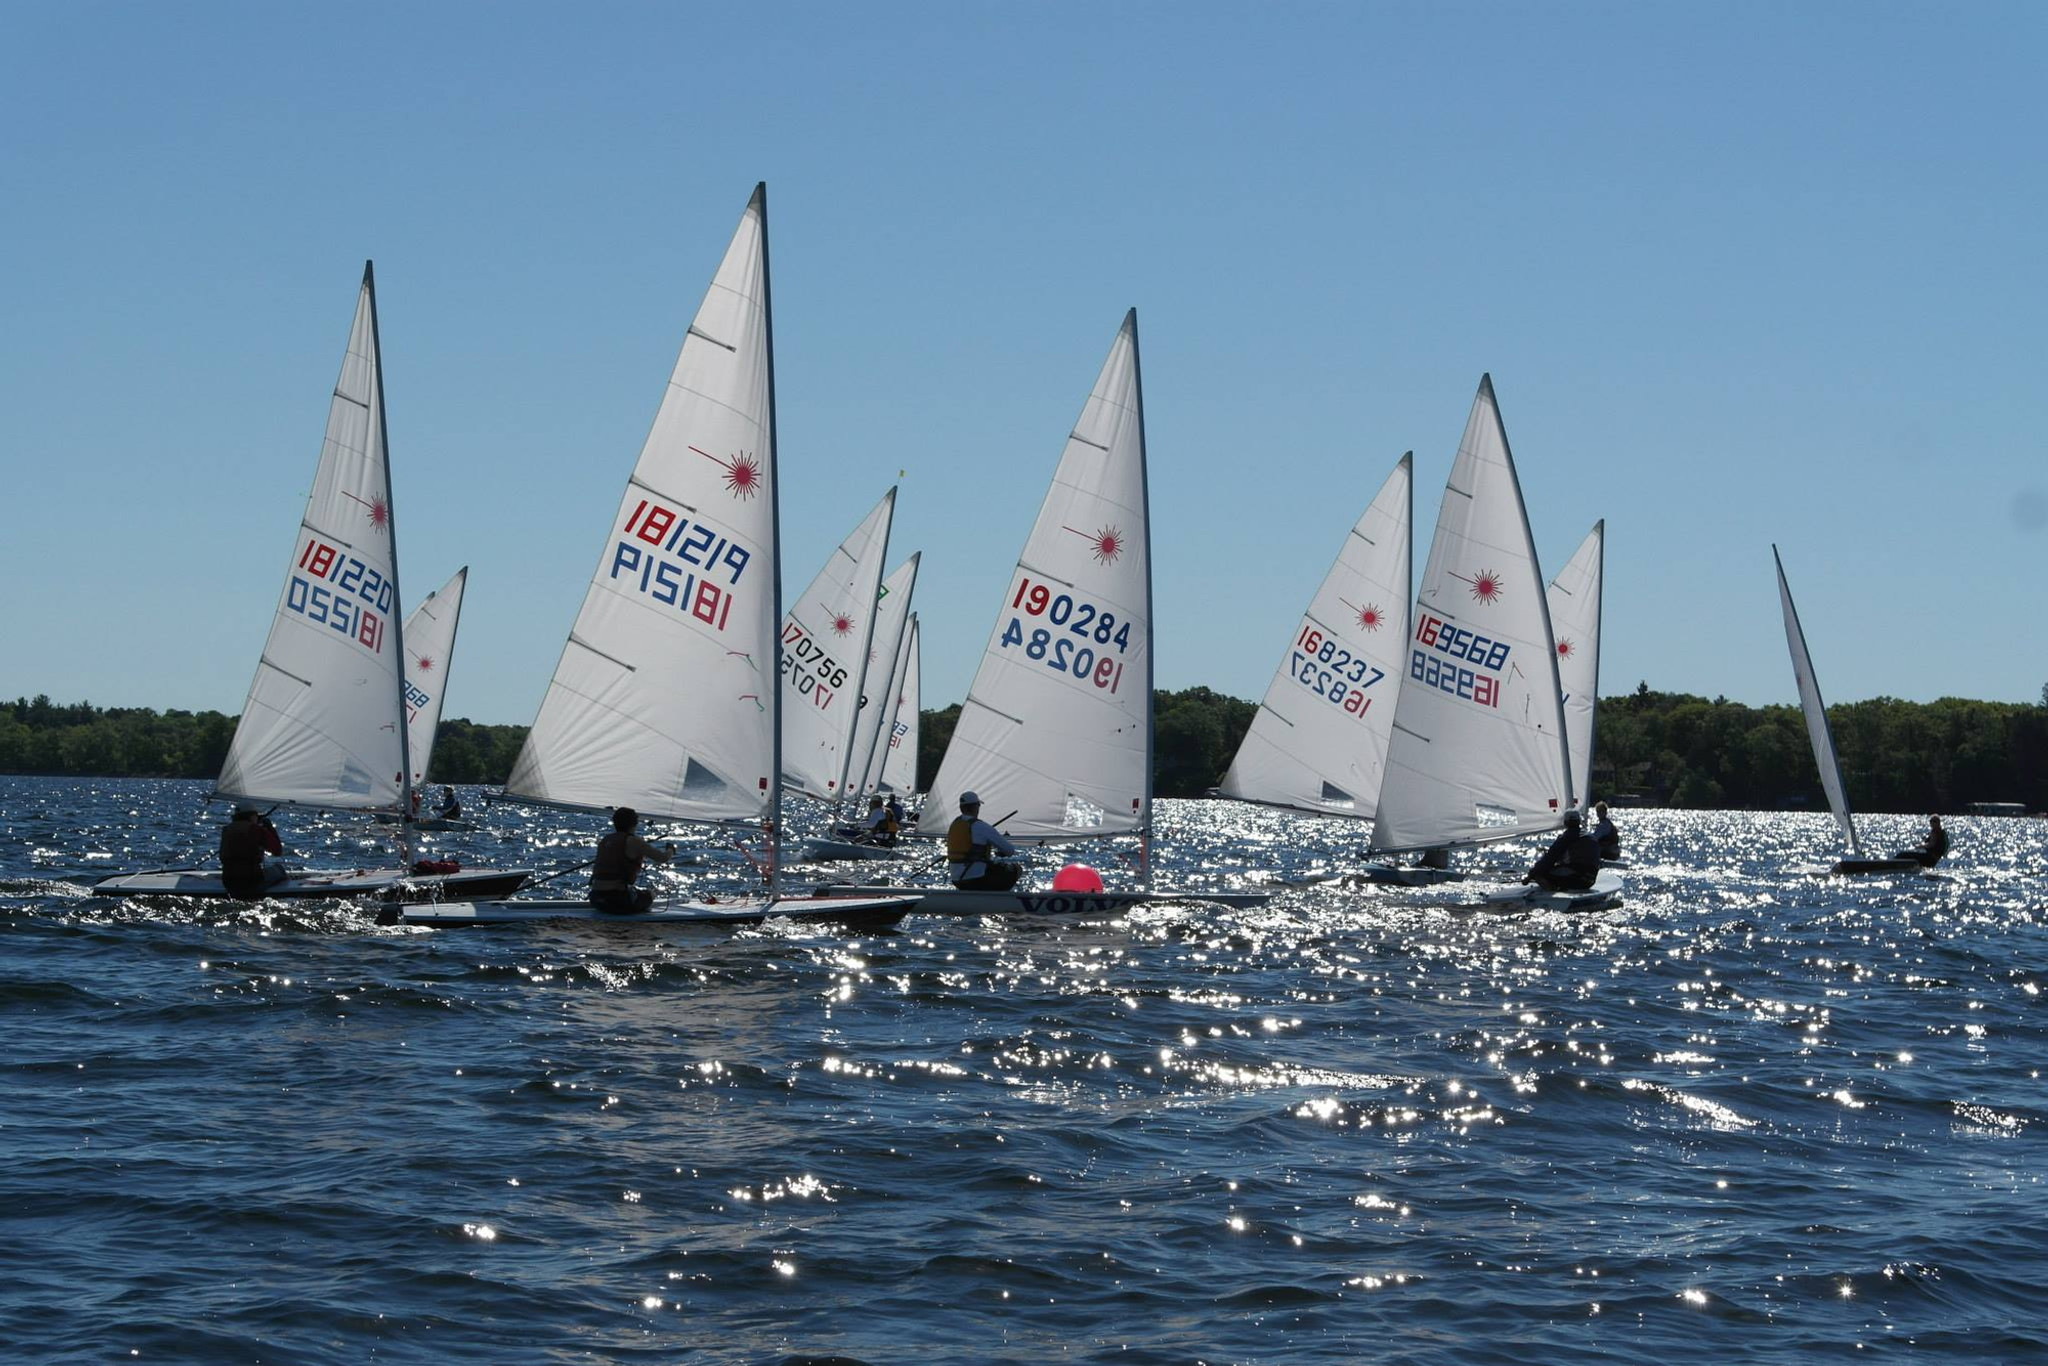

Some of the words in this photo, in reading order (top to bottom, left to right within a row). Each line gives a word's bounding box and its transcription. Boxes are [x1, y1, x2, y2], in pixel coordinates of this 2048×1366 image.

[299, 540, 393, 615] 181220
[624, 500, 750, 585] 181219
[1012, 578, 1130, 654] 190284
[1415, 613, 1510, 671] 169568
[781, 622, 848, 689] 170756
[1297, 625, 1384, 688] 168237
